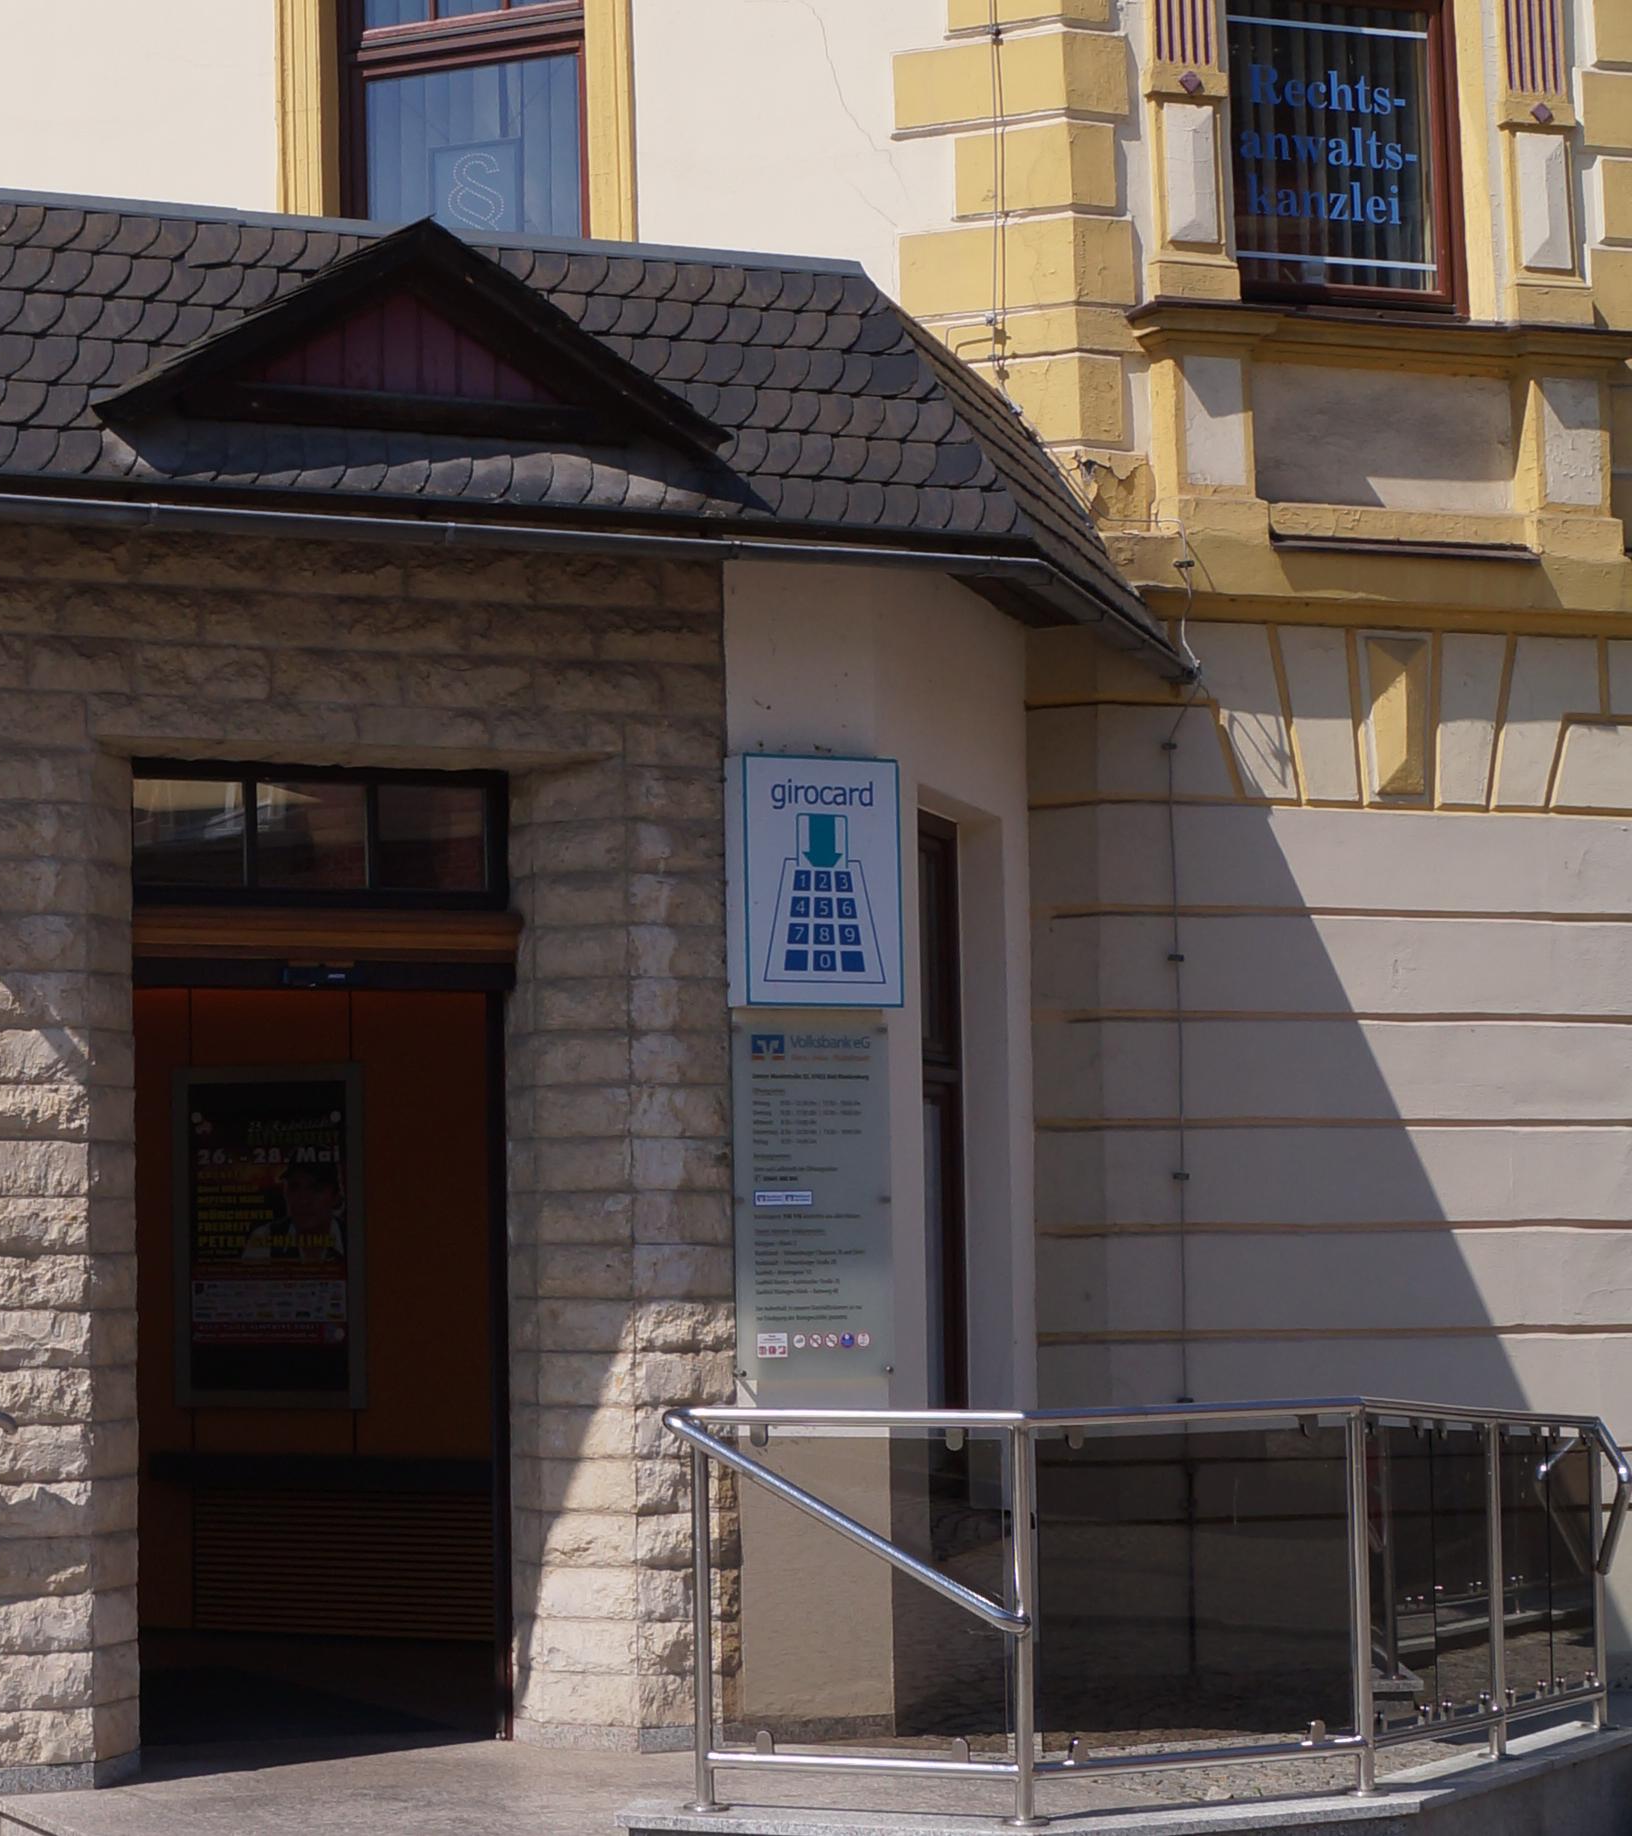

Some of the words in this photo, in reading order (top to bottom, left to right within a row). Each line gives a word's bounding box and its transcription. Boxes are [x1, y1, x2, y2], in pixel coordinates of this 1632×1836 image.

[1247, 63, 1406, 116] Rechts-
[1240, 127, 1418, 171] anwalts-
[1247, 173, 1402, 225] kanzlei
[770, 779, 874, 810] girocard
[799, 874, 807, 888] 1
[819, 873, 829, 889] 2
[839, 874, 849, 890] 3
[795, 900, 805, 915] 4
[819, 901, 829, 916] 5
[842, 901, 853, 916] 6
[794, 926, 805, 941] 7
[819, 927, 830, 942] 8
[845, 927, 855, 943] 9
[820, 953, 831, 969] 0
[790, 1034, 853, 1049] Volksbank
[853, 1036, 871, 1049] eG
[197, 1147, 233, 1165] 26.
[253, 1147, 289, 1164] 28.
[296, 1145, 340, 1163] Mai
[197, 1234, 246, 1248] PETER
